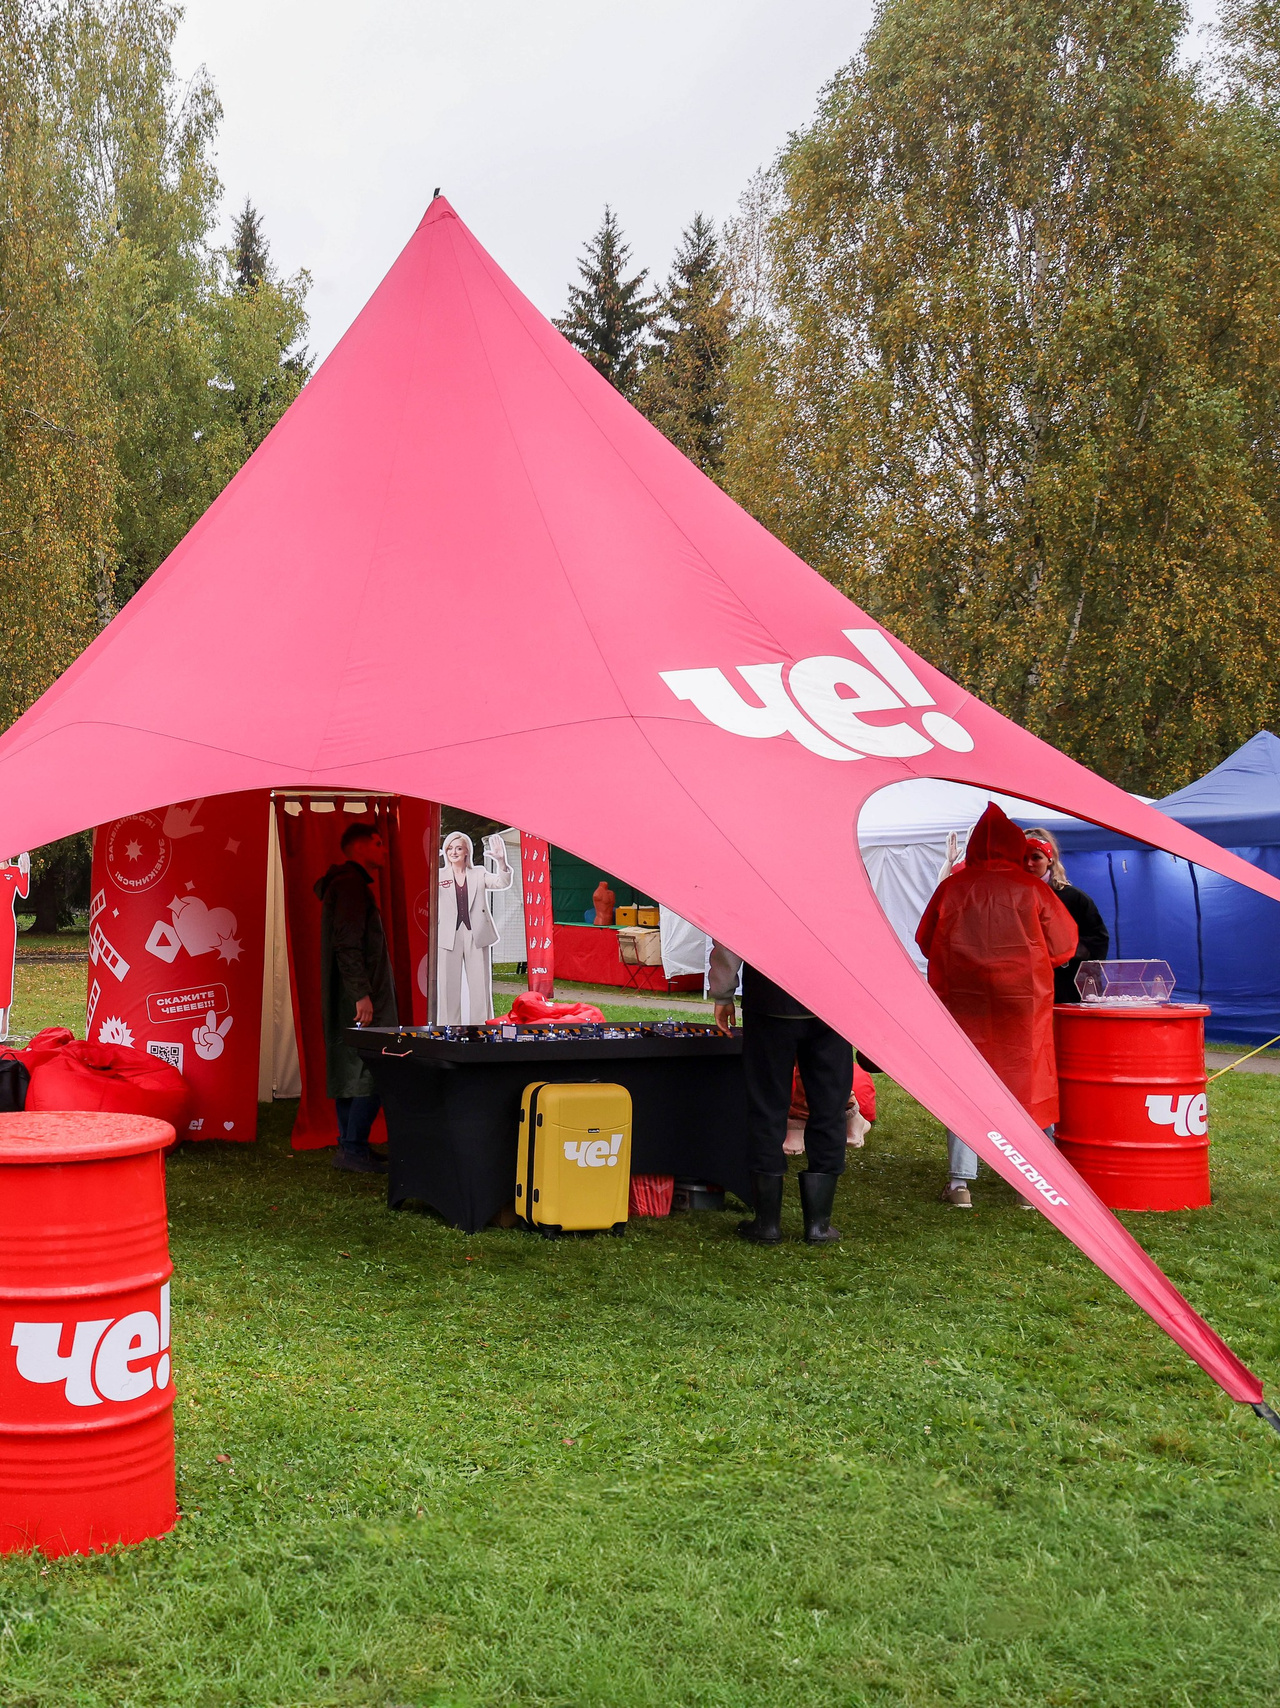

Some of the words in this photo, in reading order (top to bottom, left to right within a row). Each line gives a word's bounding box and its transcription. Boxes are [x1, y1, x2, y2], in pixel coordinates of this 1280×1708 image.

[156, 990, 215, 1006] СКАЖИТЕ
[161, 1000, 215, 1015] ЧЕЕЕЕЕ!!!
[1144, 1092, 1208, 1137] че
